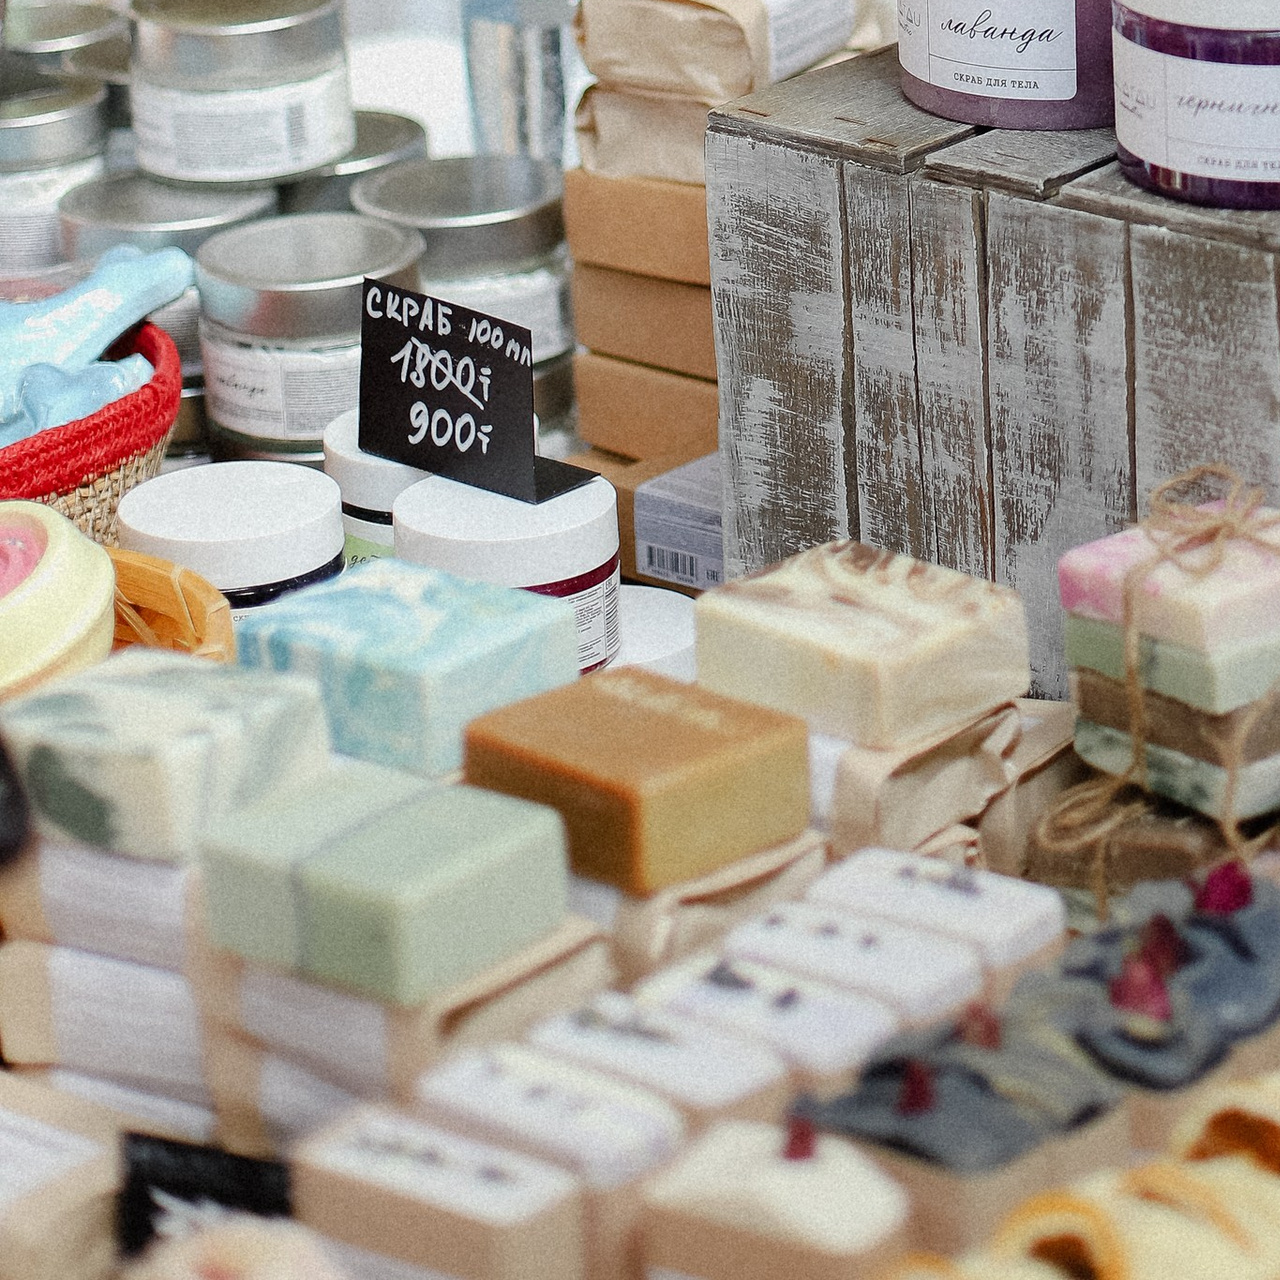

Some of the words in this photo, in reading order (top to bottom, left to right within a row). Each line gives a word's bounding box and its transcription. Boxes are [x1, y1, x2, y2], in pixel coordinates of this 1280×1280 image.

[940, 9, 1063, 54] лаванда
[953, 72, 983, 85] СКРАБ
[985, 78, 1008, 89] ДЛЯ
[1011, 80, 1040, 90] ТЕЛА
[366, 286, 453, 337] СКРАБ
